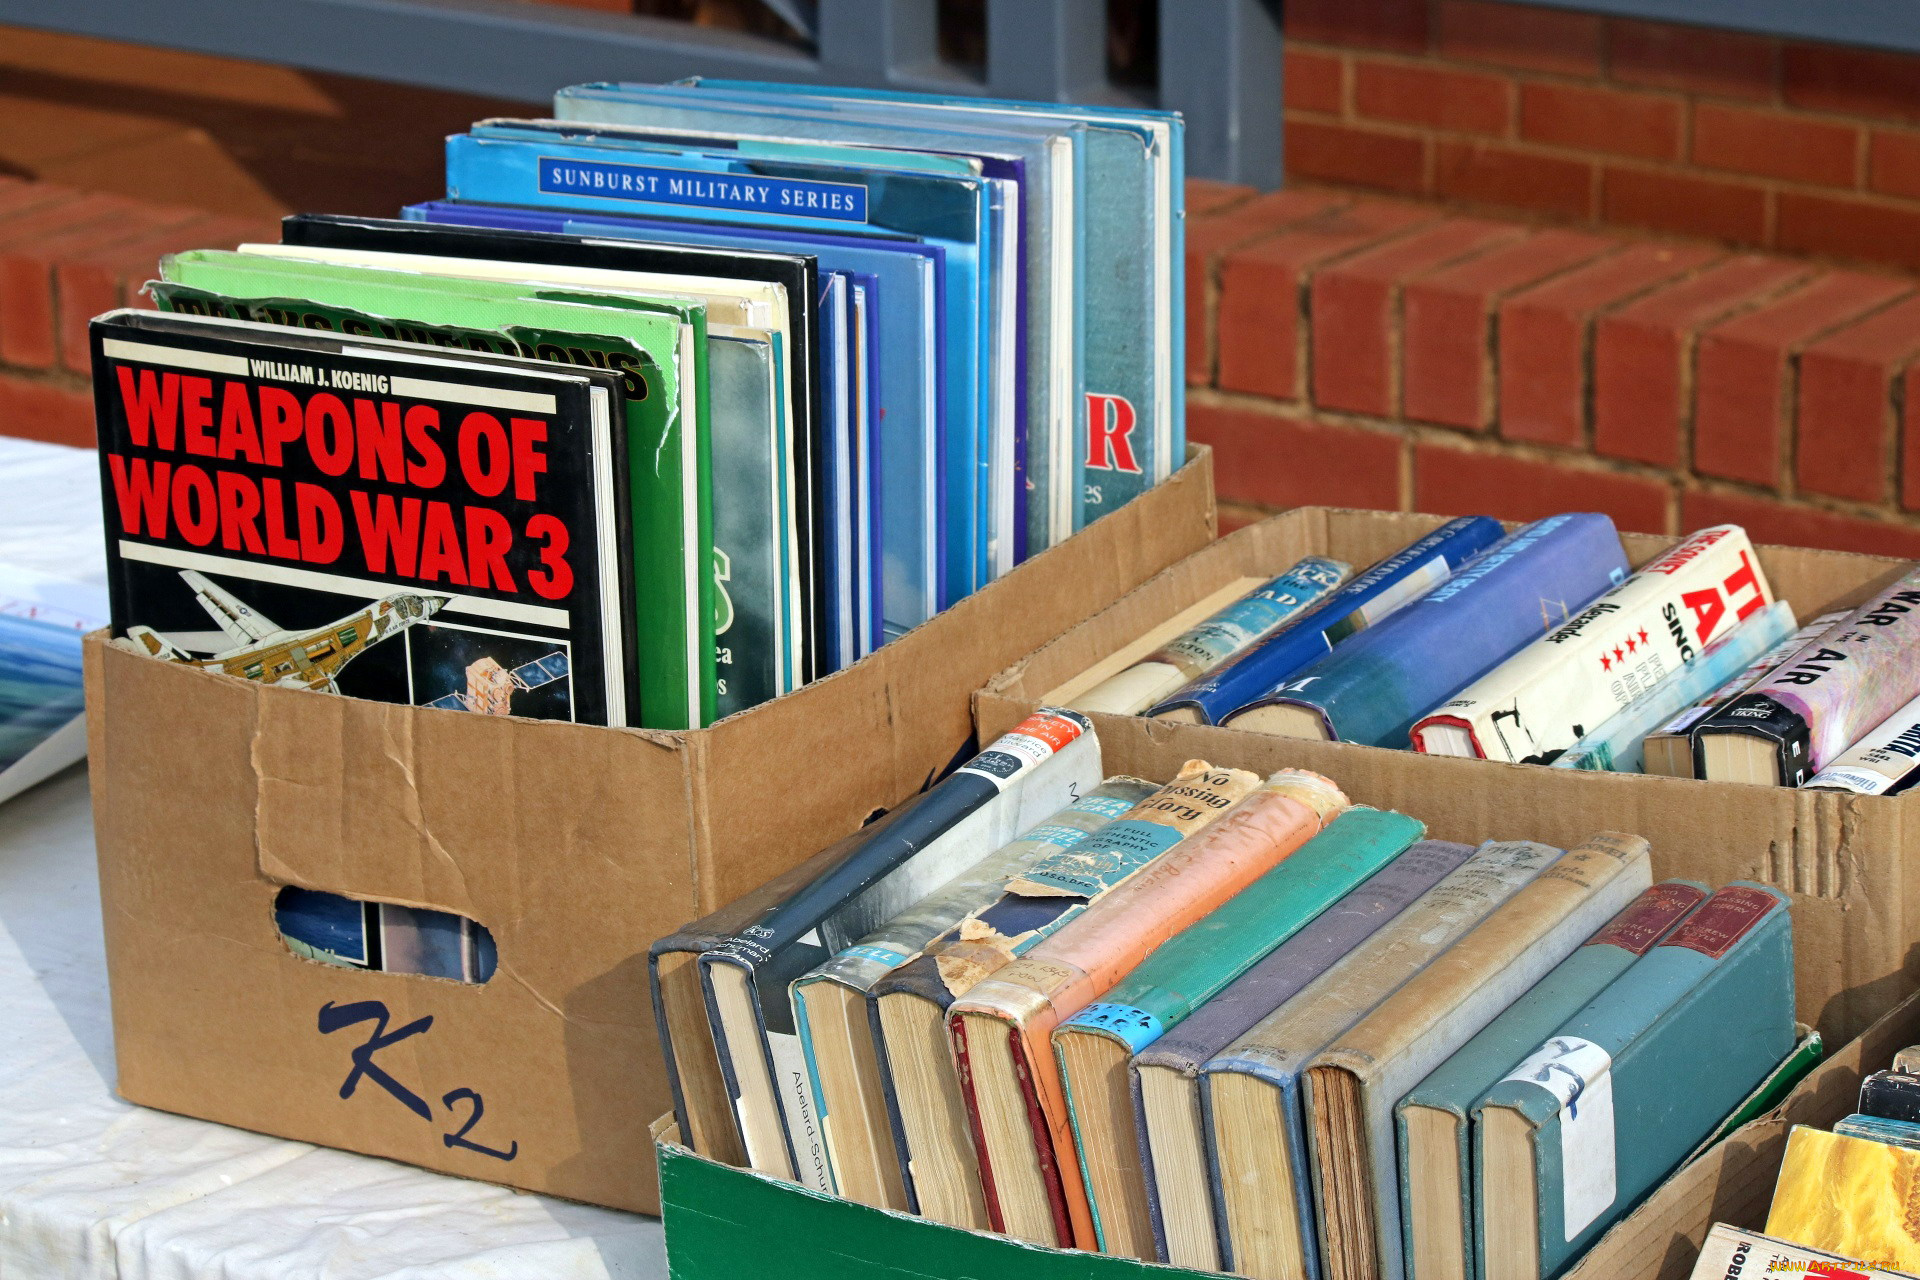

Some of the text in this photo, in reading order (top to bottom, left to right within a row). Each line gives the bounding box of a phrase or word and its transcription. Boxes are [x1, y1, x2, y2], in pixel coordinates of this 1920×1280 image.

[552, 167, 856, 212] SUNBURST MILITARY SERIES
[250, 358, 389, 395] WILLIAM J. KOENIG
[116, 365, 548, 501] WEAPONS OF
[108, 453, 575, 601] WORLD WAR 3
[1545, 603, 1621, 644] Alexander
[1855, 591, 1920, 625] WAR
[1773, 647, 1848, 685] AIR
[1730, 710, 1771, 720] VIKING
[1041, 731, 1061, 746] AIR
[1124, 827, 1153, 838] FULL
